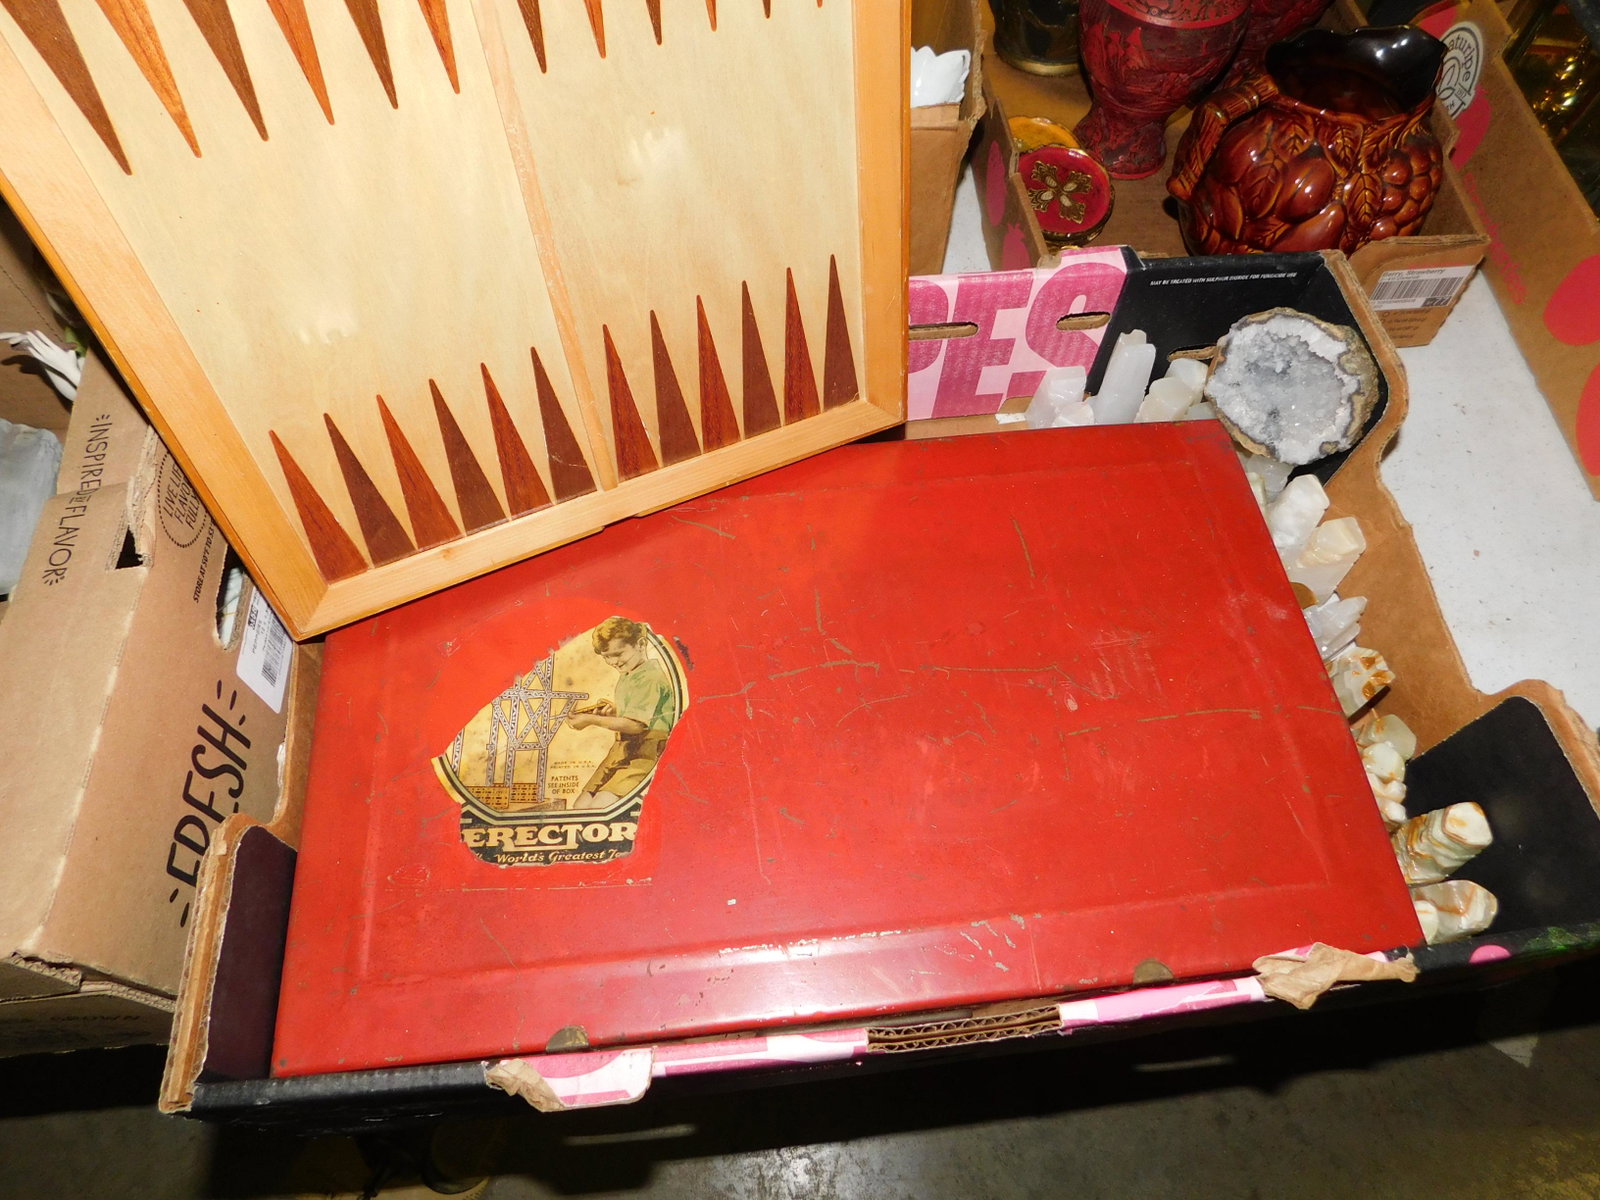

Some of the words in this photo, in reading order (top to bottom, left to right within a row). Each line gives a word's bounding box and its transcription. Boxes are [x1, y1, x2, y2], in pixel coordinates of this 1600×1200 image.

[1447, 34, 1475, 82] aturipe
[76, 422, 112, 497] INSPIRED
[169, 463, 184, 486] LIF
[163, 484, 179, 518] LIVE
[42, 505, 87, 579] FLAVOR
[193, 576, 204, 604] STORE
[462, 823, 638, 852] ERECTOR
[548, 849, 605, 865] Greatest
